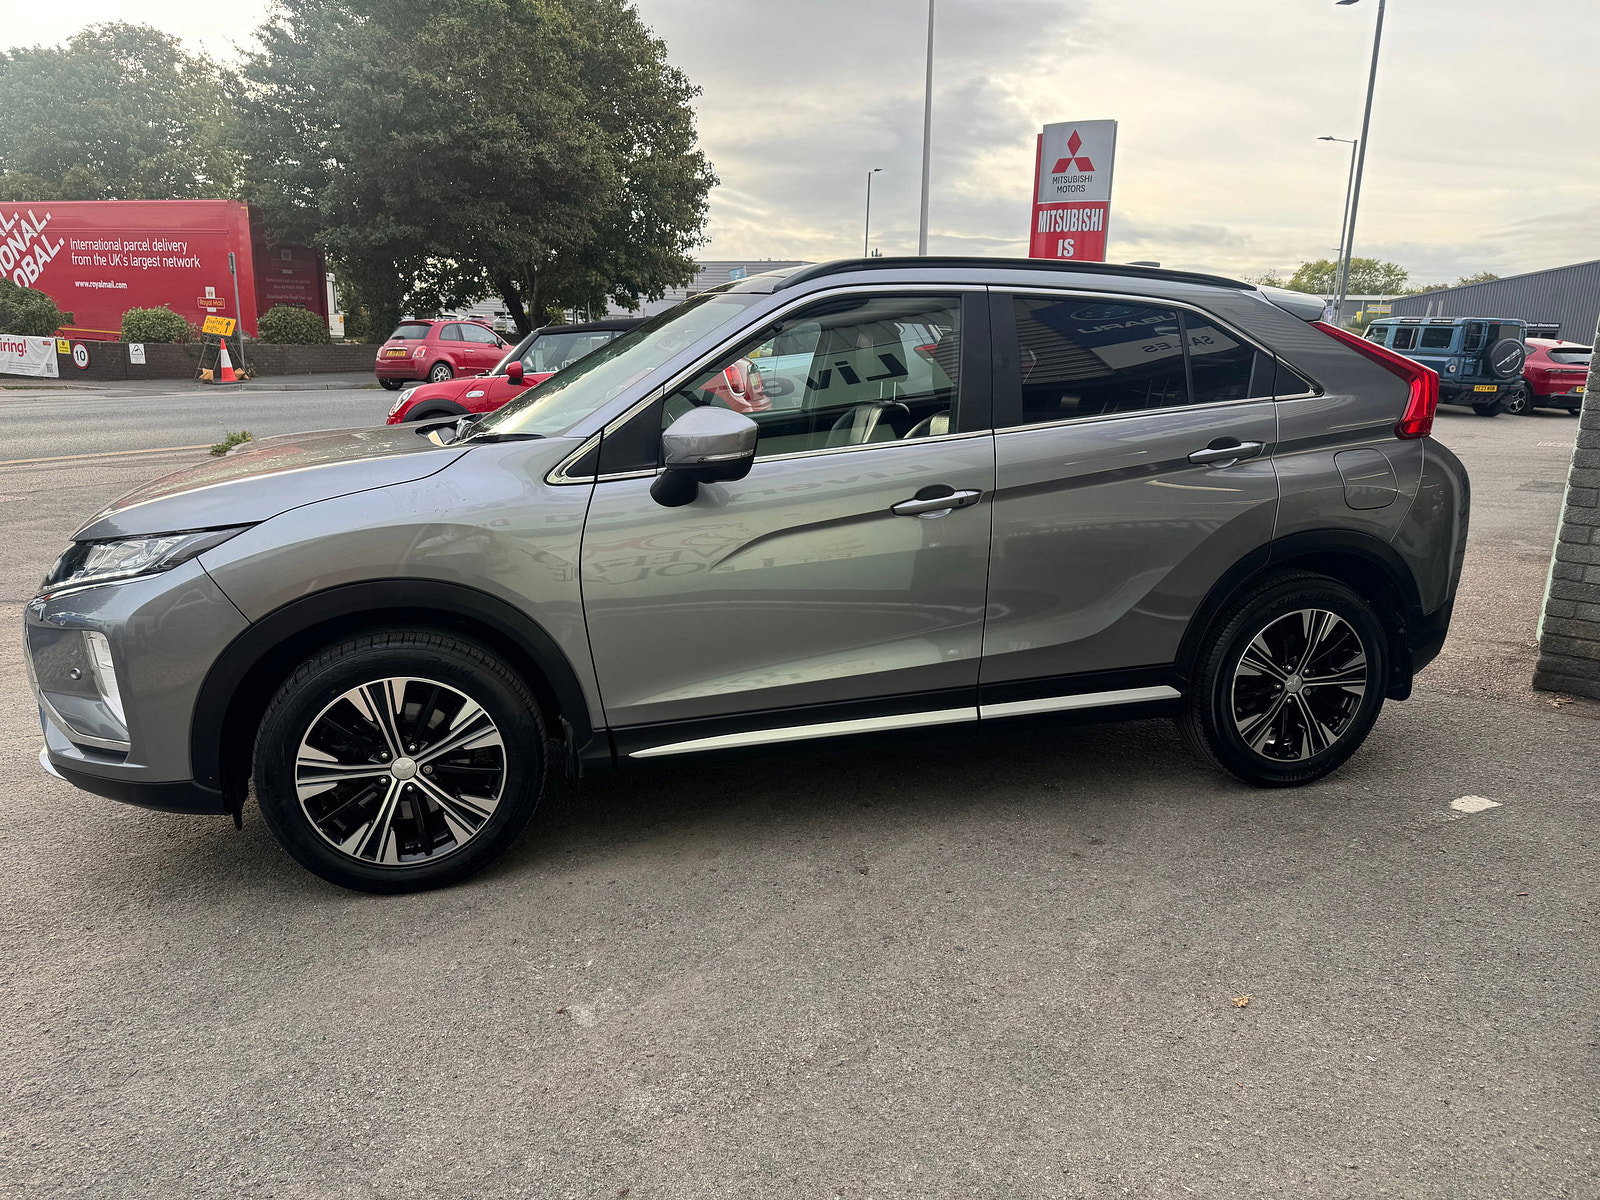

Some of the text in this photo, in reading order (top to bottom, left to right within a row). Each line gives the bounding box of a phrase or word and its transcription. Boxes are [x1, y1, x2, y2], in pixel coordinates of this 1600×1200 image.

[1052, 175, 1093, 184] MITSUBISHI
[1056, 184, 1086, 193] MOTORS
[1037, 208, 1104, 233] MITSUBISHI
[70, 238, 188, 255] International parcel delivery
[1057, 238, 1075, 257] IS
[71, 252, 201, 270] from the UK's largest network
[74, 280, 128, 289] www.royalmail.com
[75, 350, 86, 361] 10
